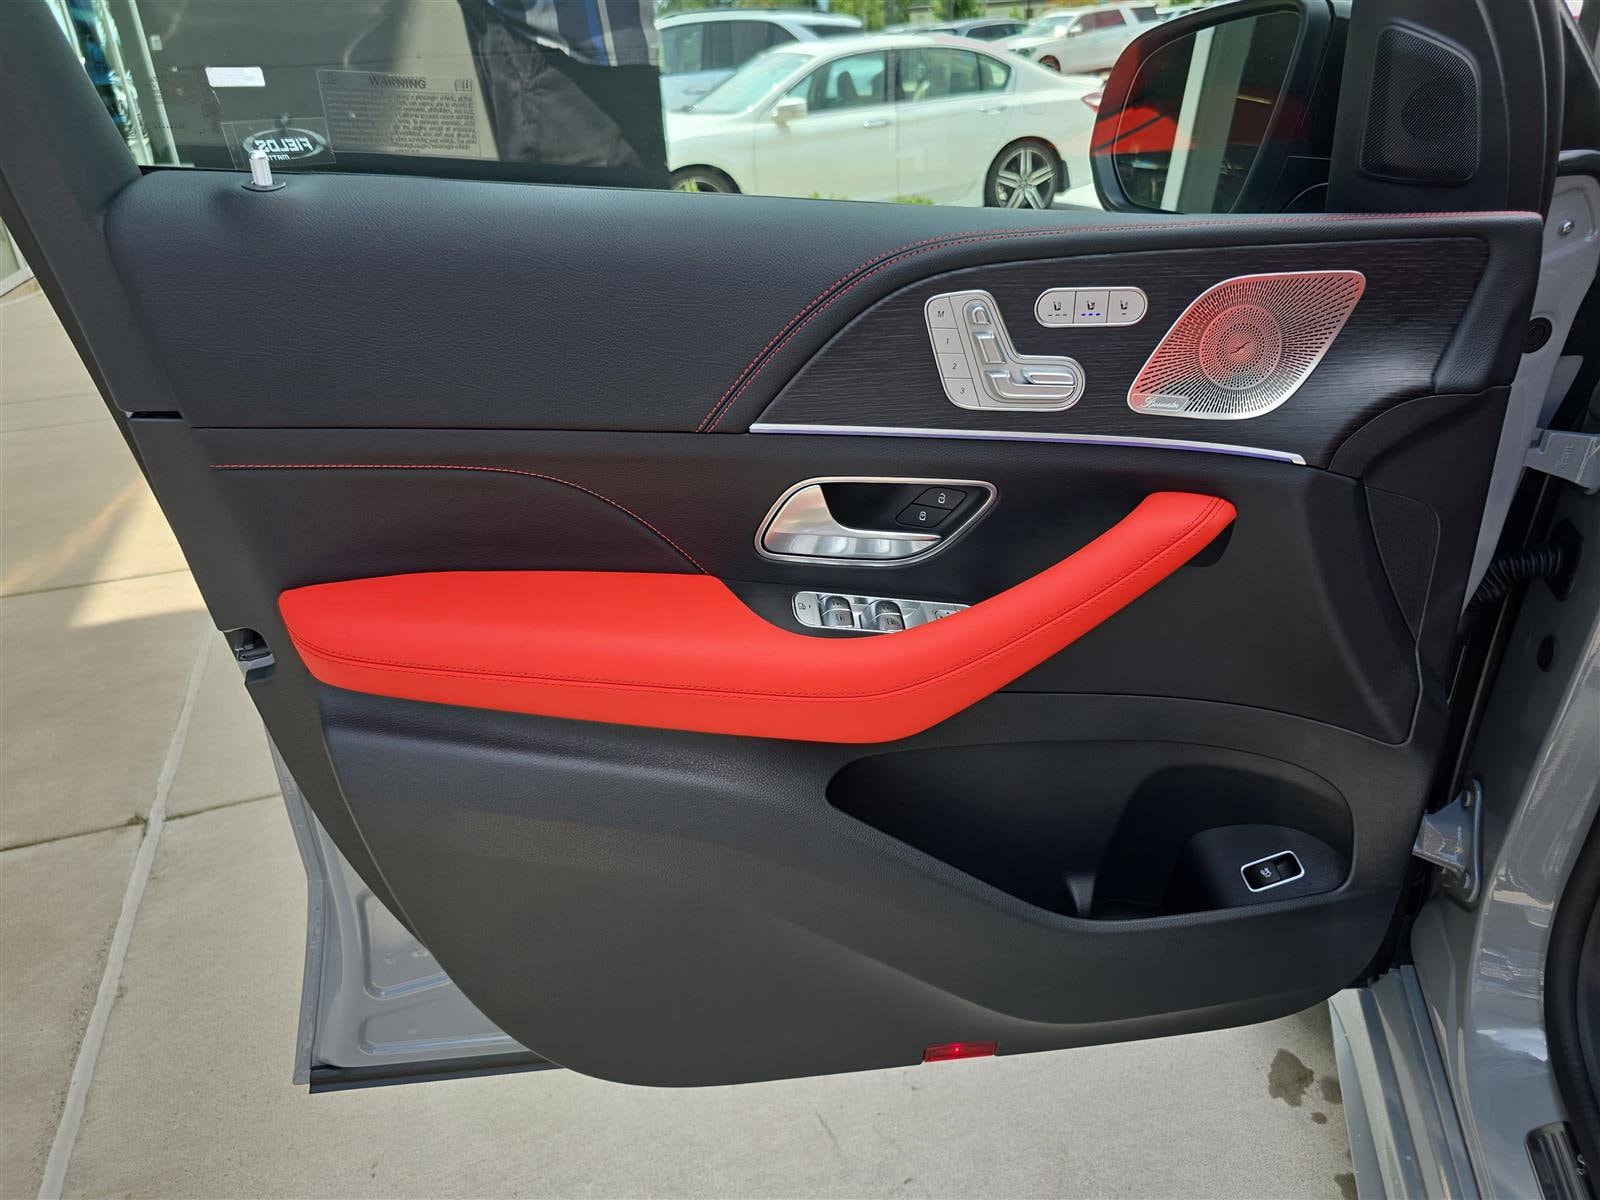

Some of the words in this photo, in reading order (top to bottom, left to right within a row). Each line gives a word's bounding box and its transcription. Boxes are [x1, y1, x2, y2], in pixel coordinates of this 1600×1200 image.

[368, 73, 427, 89] WARNING
[937, 310, 945, 318] M
[952, 362, 957, 370] 2
[960, 386, 965, 394] 3
